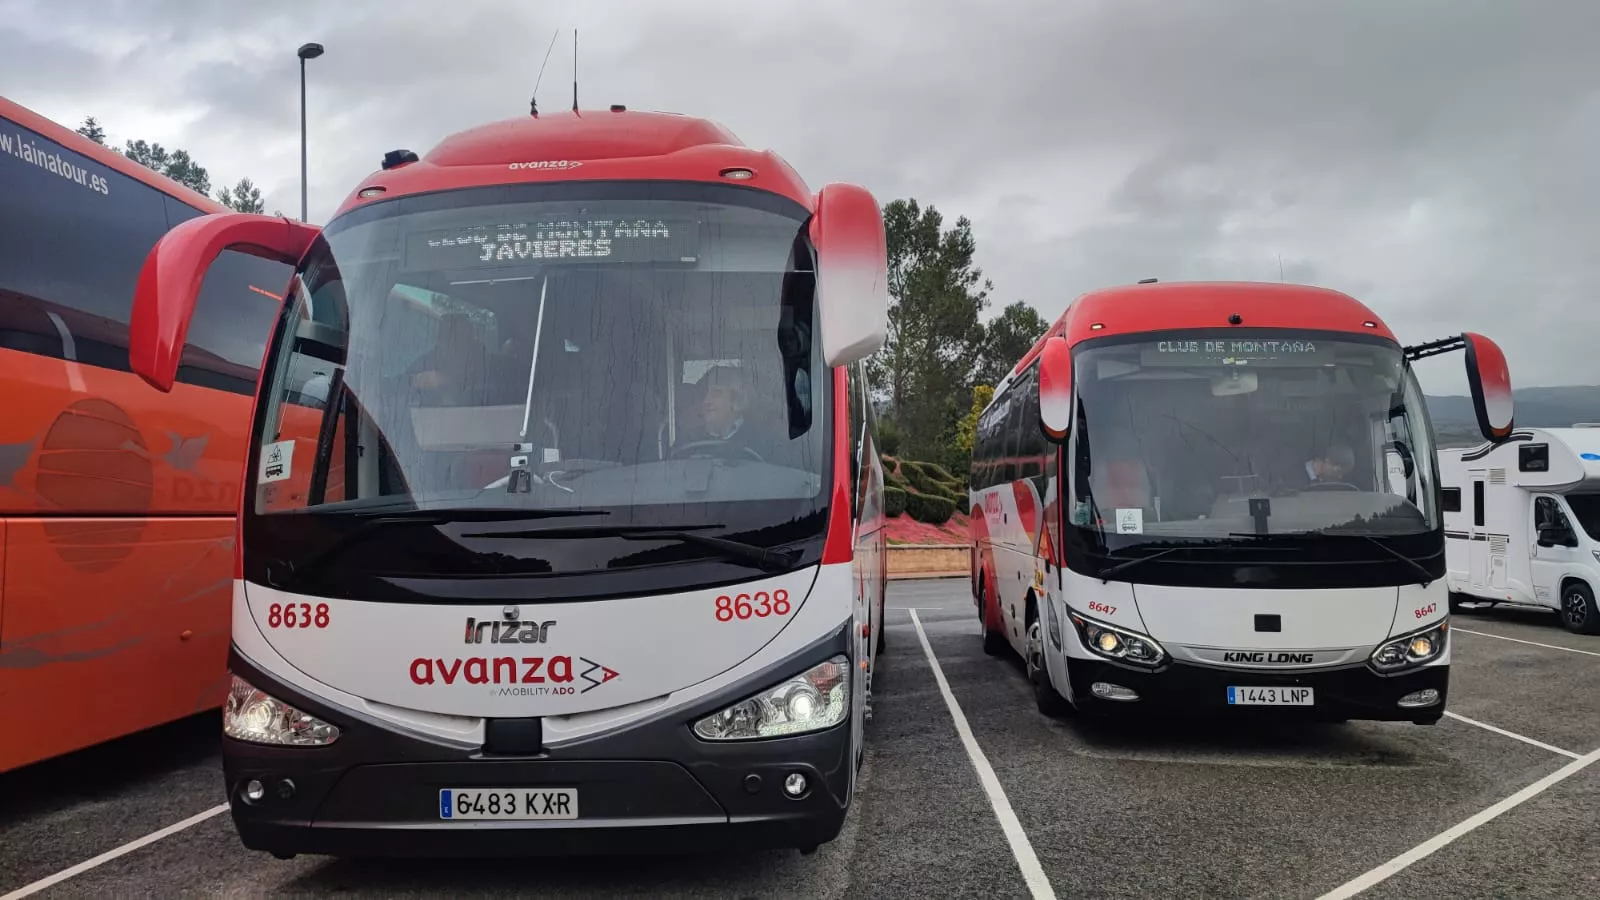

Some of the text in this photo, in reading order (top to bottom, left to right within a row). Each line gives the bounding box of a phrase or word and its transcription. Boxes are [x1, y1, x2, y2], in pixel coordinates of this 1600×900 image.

[508, 159, 568, 170] avanza
[536, 219, 669, 239] MONTAÑA
[480, 239, 612, 261] JAVIERES
[1157, 340, 1316, 353] CLUB DE MONTAÑA
[714, 588, 791, 622] 8638
[1088, 600, 1118, 616] 8647
[1414, 602, 1437, 619] 8647
[267, 602, 330, 629] 8638
[1223, 652, 1314, 663] KING LONG
[409, 655, 574, 685] avanza
[498, 687, 550, 697] MOBILITY
[551, 686, 575, 695] ADO
[1240, 689, 1310, 704] 1443 LNP
[457, 793, 516, 815] 6483
[525, 792, 571, 815] KXR
